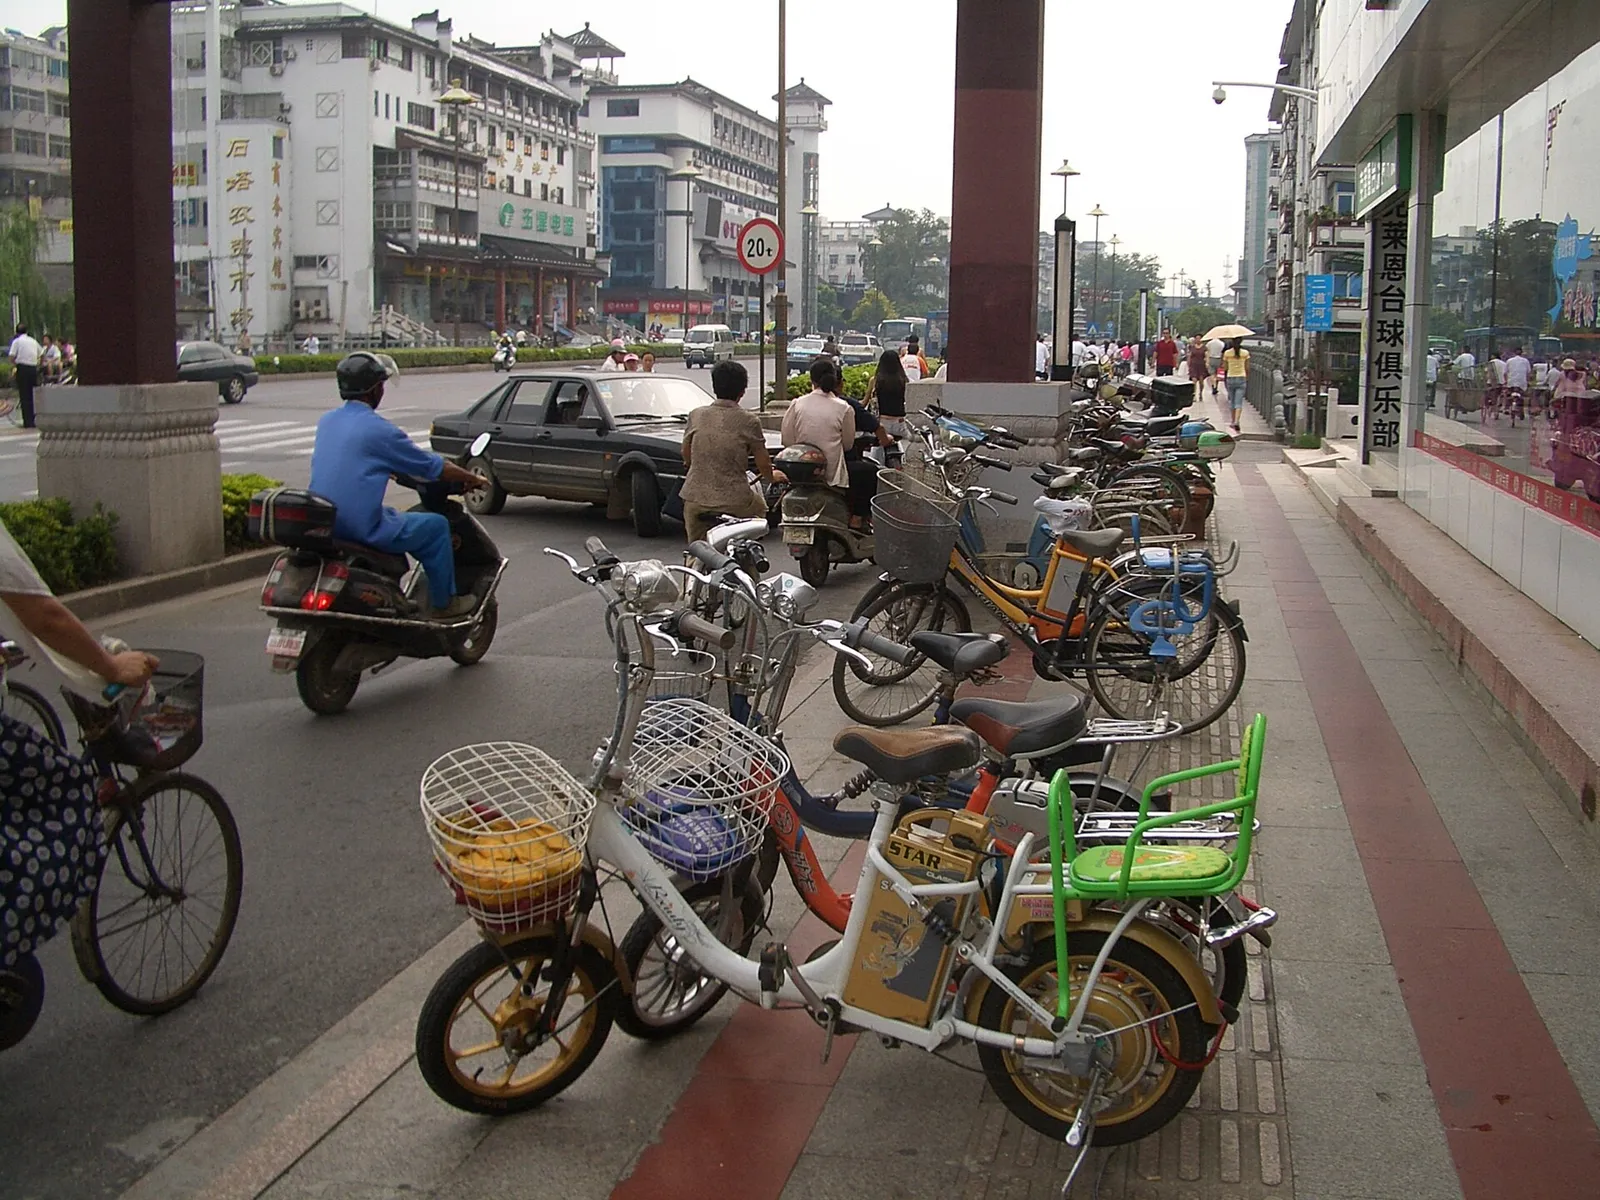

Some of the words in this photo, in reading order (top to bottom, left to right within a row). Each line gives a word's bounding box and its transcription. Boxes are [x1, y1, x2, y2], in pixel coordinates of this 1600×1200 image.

[1311, 279, 1327, 319] 二道河
[888, 840, 942, 870] STAR
